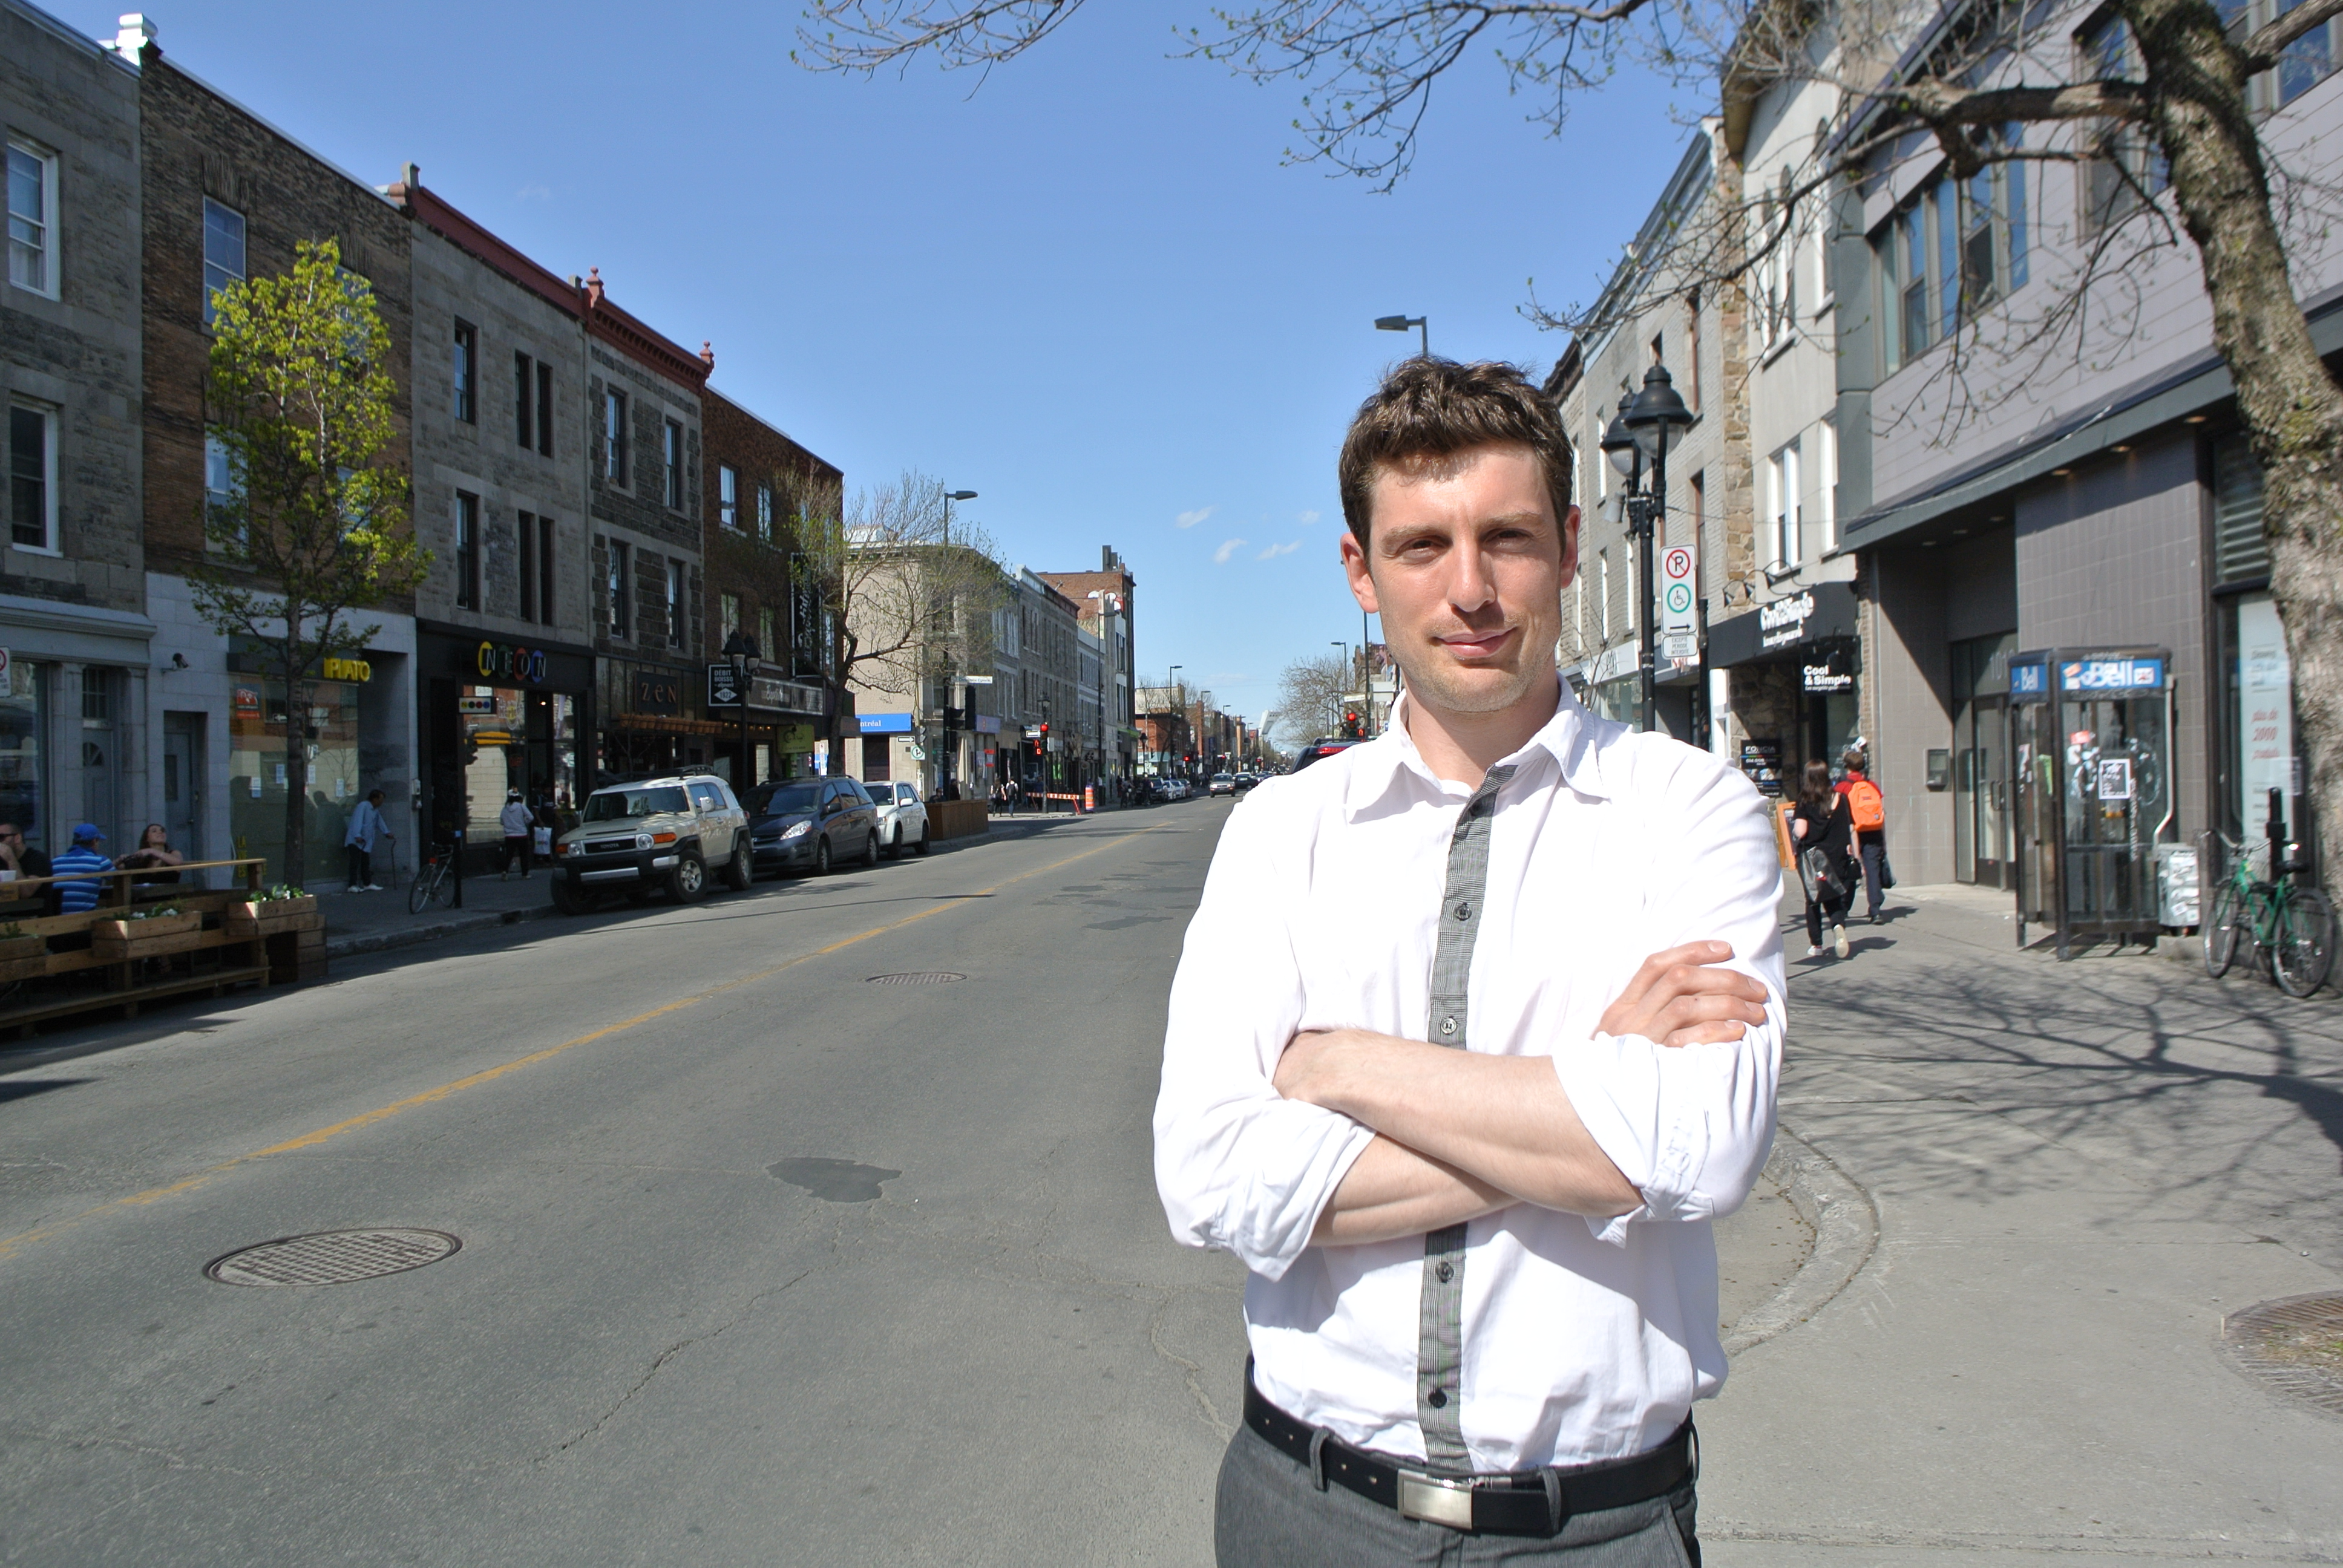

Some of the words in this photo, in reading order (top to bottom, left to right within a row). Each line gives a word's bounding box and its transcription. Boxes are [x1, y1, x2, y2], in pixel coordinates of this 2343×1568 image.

[486, 648, 546, 678] NEON
[1804, 665, 1829, 675] Cool
[2088, 661, 2133, 687] Bell
[1814, 675, 1852, 687] Simple
[2021, 666, 2038, 691] Bell
